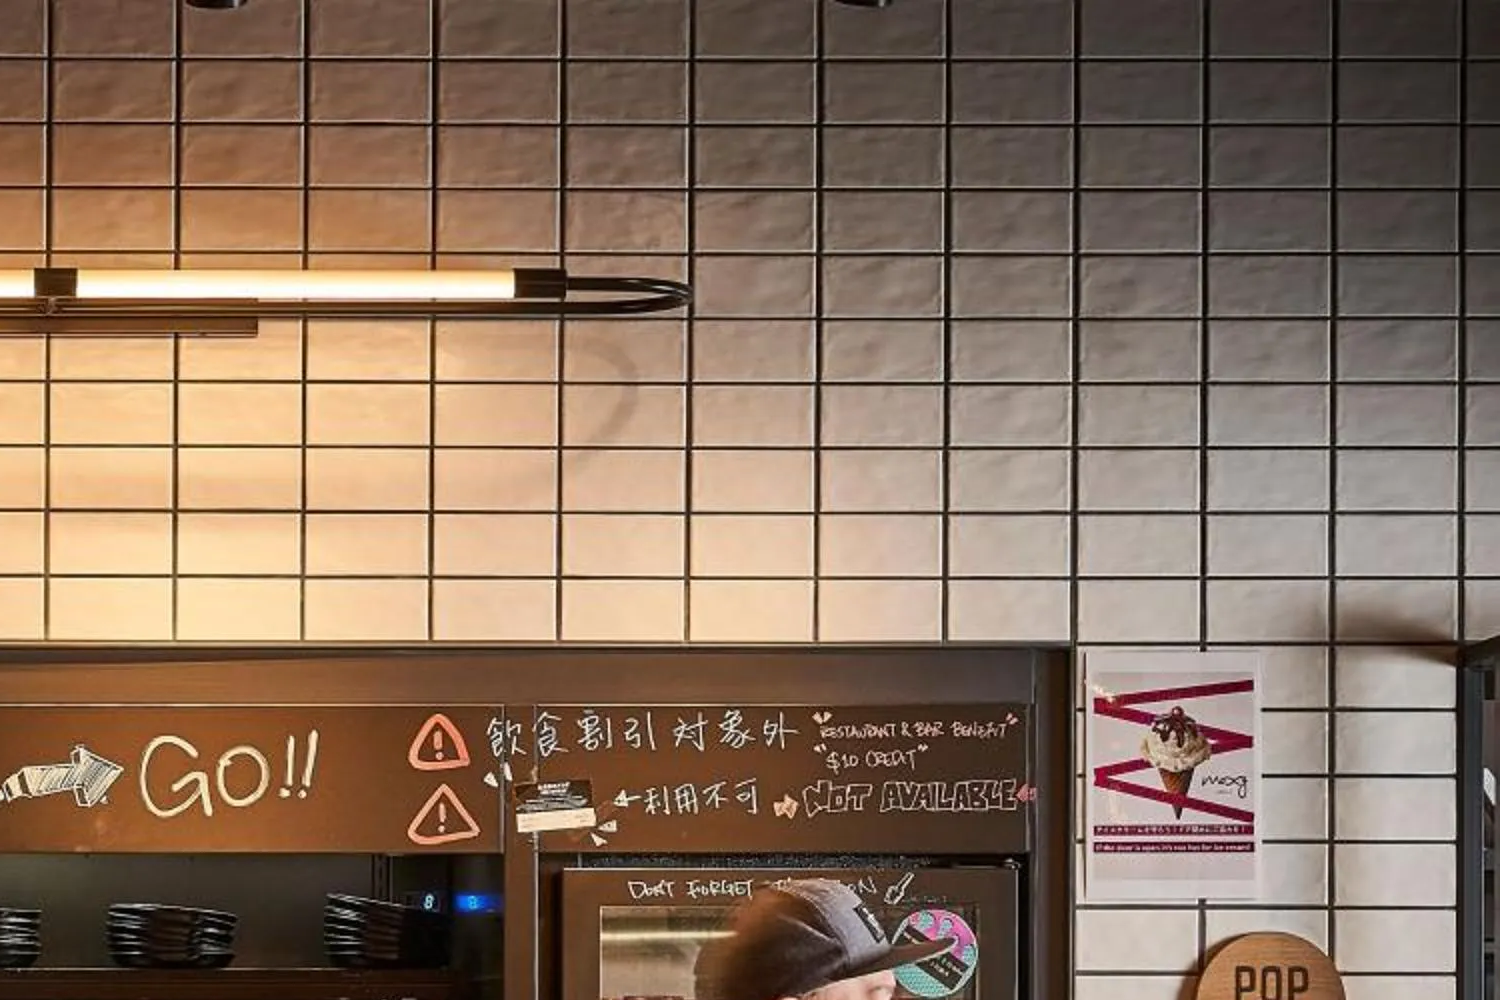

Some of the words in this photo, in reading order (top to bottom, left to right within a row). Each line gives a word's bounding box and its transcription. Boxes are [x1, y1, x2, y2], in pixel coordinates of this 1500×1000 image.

[485, 709, 800, 757] 飲食割引対象外
[140, 729, 319, 818] GO!!
[643, 778, 759, 816] 利用不可
[802, 779, 873, 817] NOT
[879, 779, 1017, 813] AVAILABLE
[686, 879, 754, 901] FORGET
